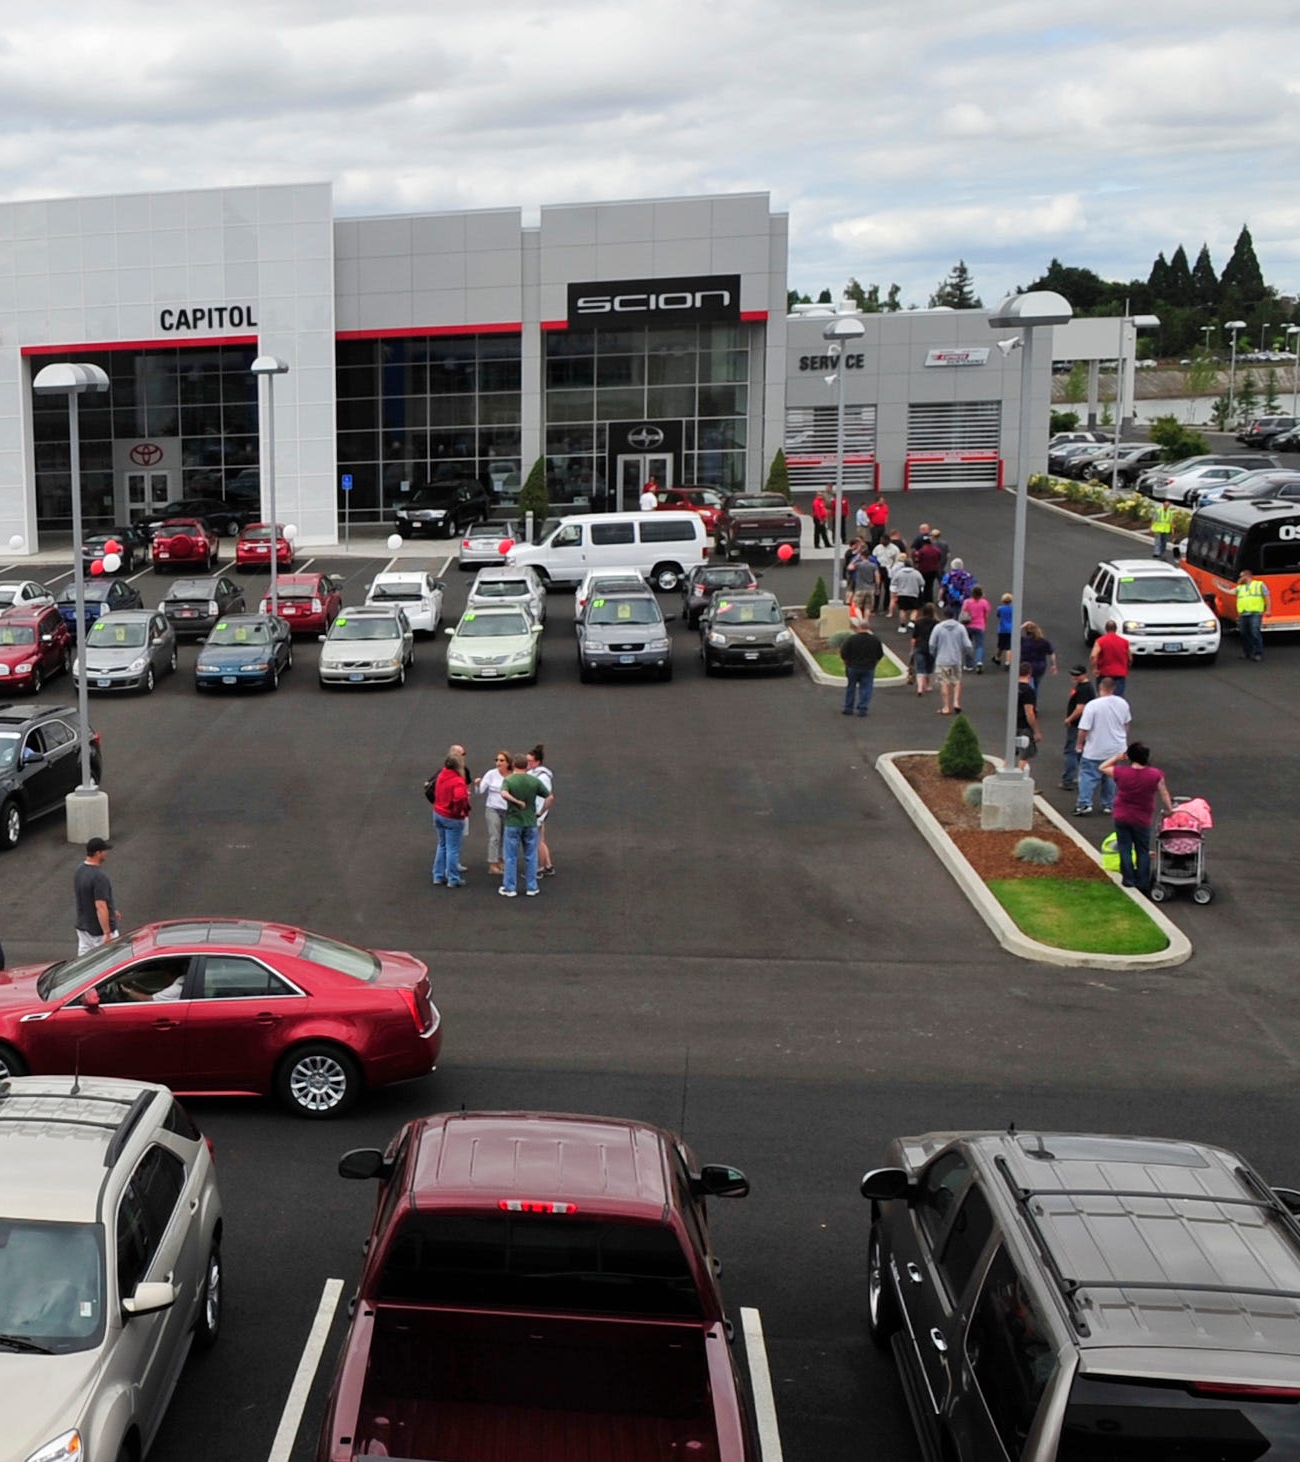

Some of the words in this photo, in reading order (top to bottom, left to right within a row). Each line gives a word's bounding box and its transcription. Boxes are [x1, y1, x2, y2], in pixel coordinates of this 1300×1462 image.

[577, 290, 730, 313] SCION
[160, 305, 258, 331] CAPITOL
[799, 353, 865, 372] SERVCE
